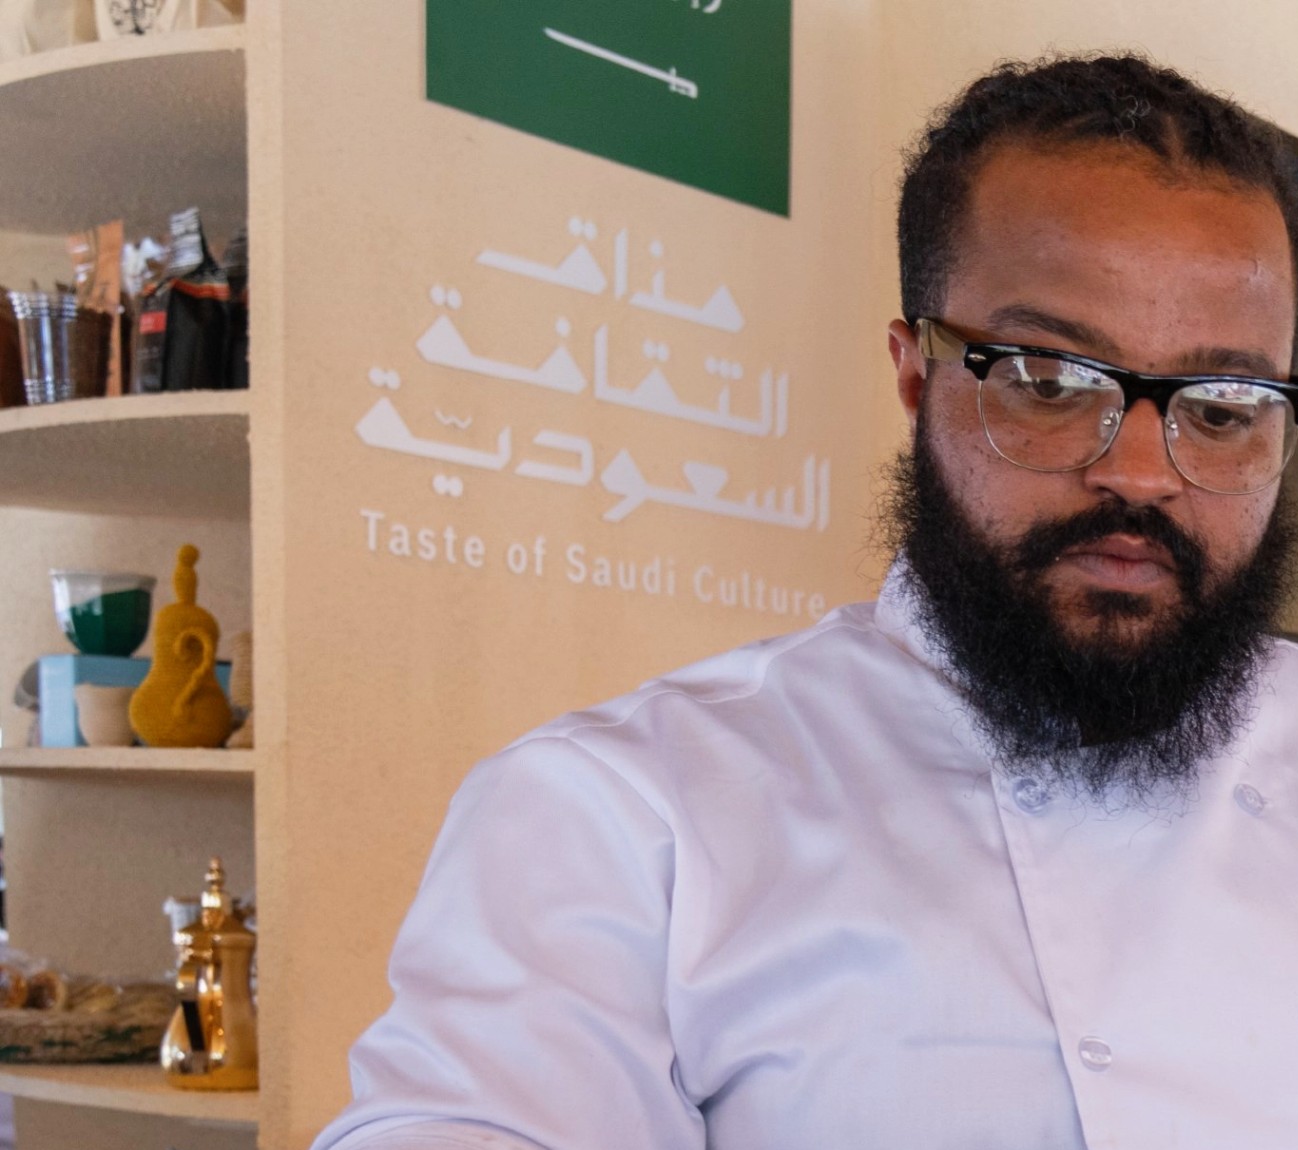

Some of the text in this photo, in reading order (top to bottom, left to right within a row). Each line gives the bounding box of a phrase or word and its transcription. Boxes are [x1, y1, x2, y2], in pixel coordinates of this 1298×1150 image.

[475, 216, 745, 333] مذاق
[415, 284, 789, 438] الثقافة
[360, 508, 826, 620] Taste of Saudi Culture
